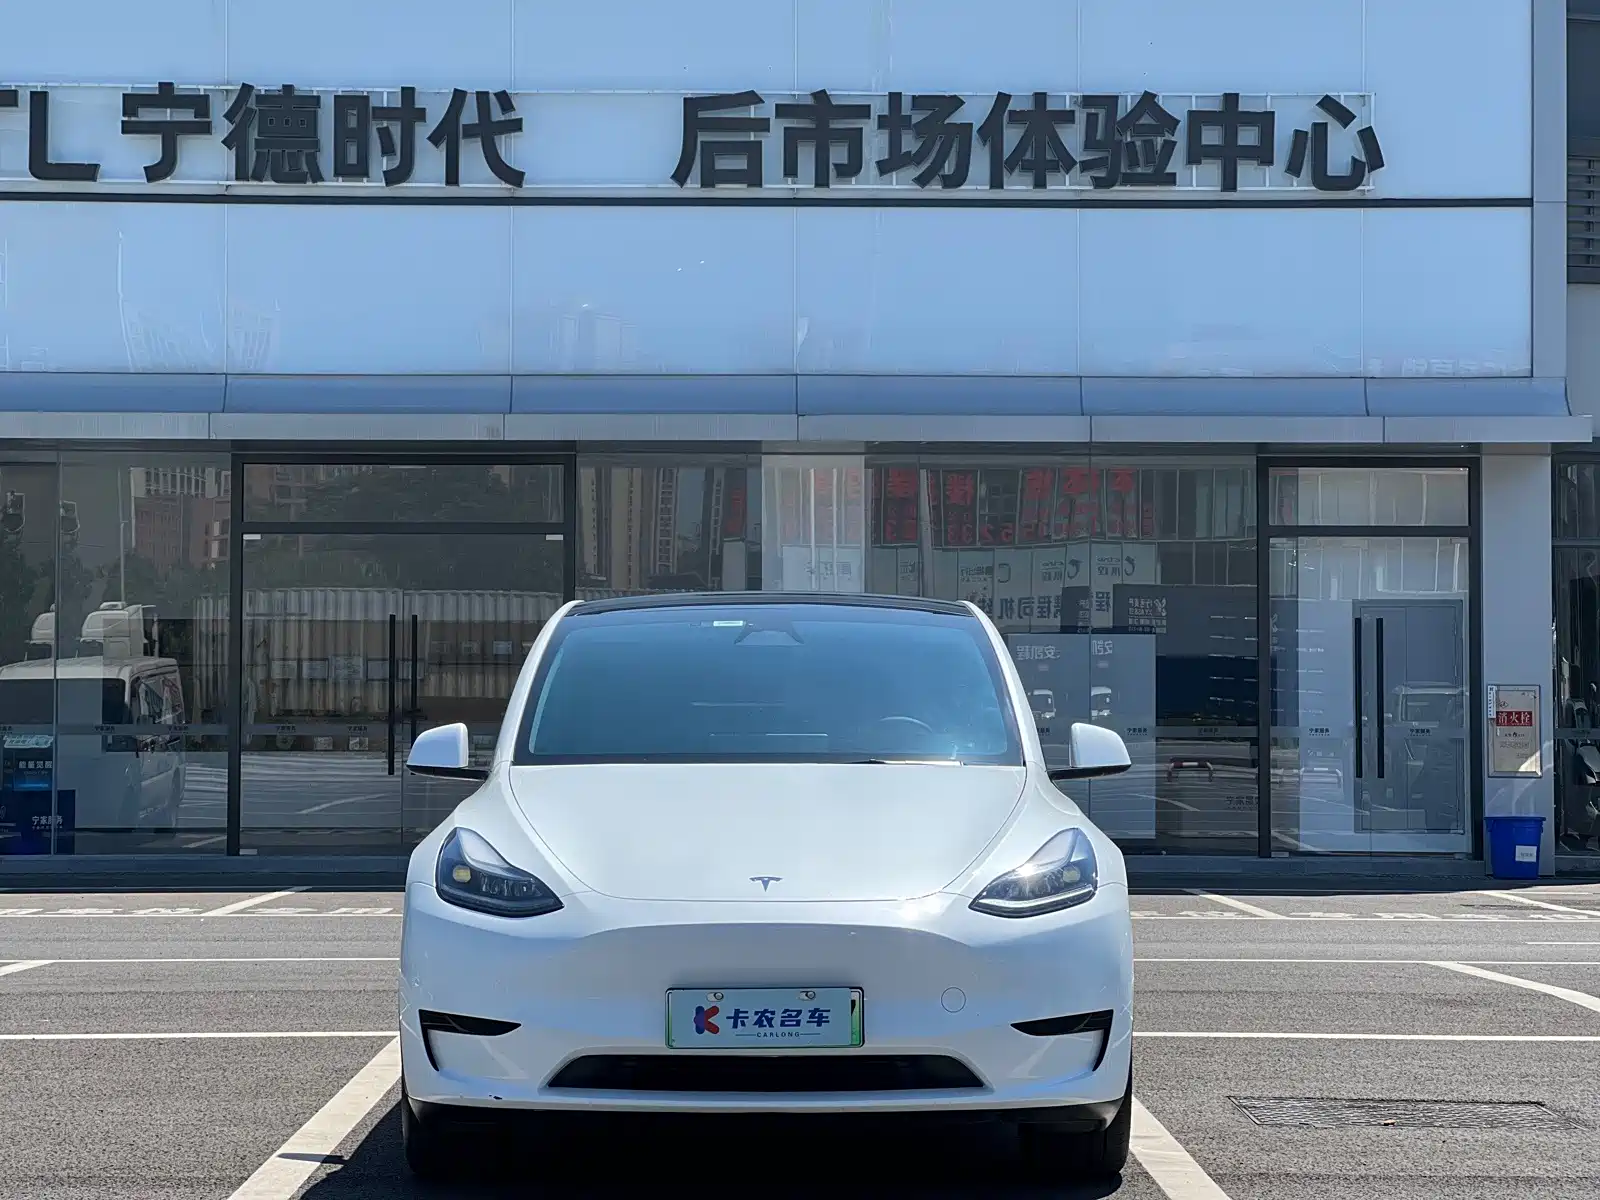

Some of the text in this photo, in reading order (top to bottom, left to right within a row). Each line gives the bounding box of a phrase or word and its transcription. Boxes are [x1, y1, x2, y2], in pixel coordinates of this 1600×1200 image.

[121, 82, 525, 189] 宁德时代
[671, 89, 1385, 192] 后市场体验中心
[1497, 711, 1531, 725] 消火栓
[726, 1007, 831, 1029] 卡农名车
